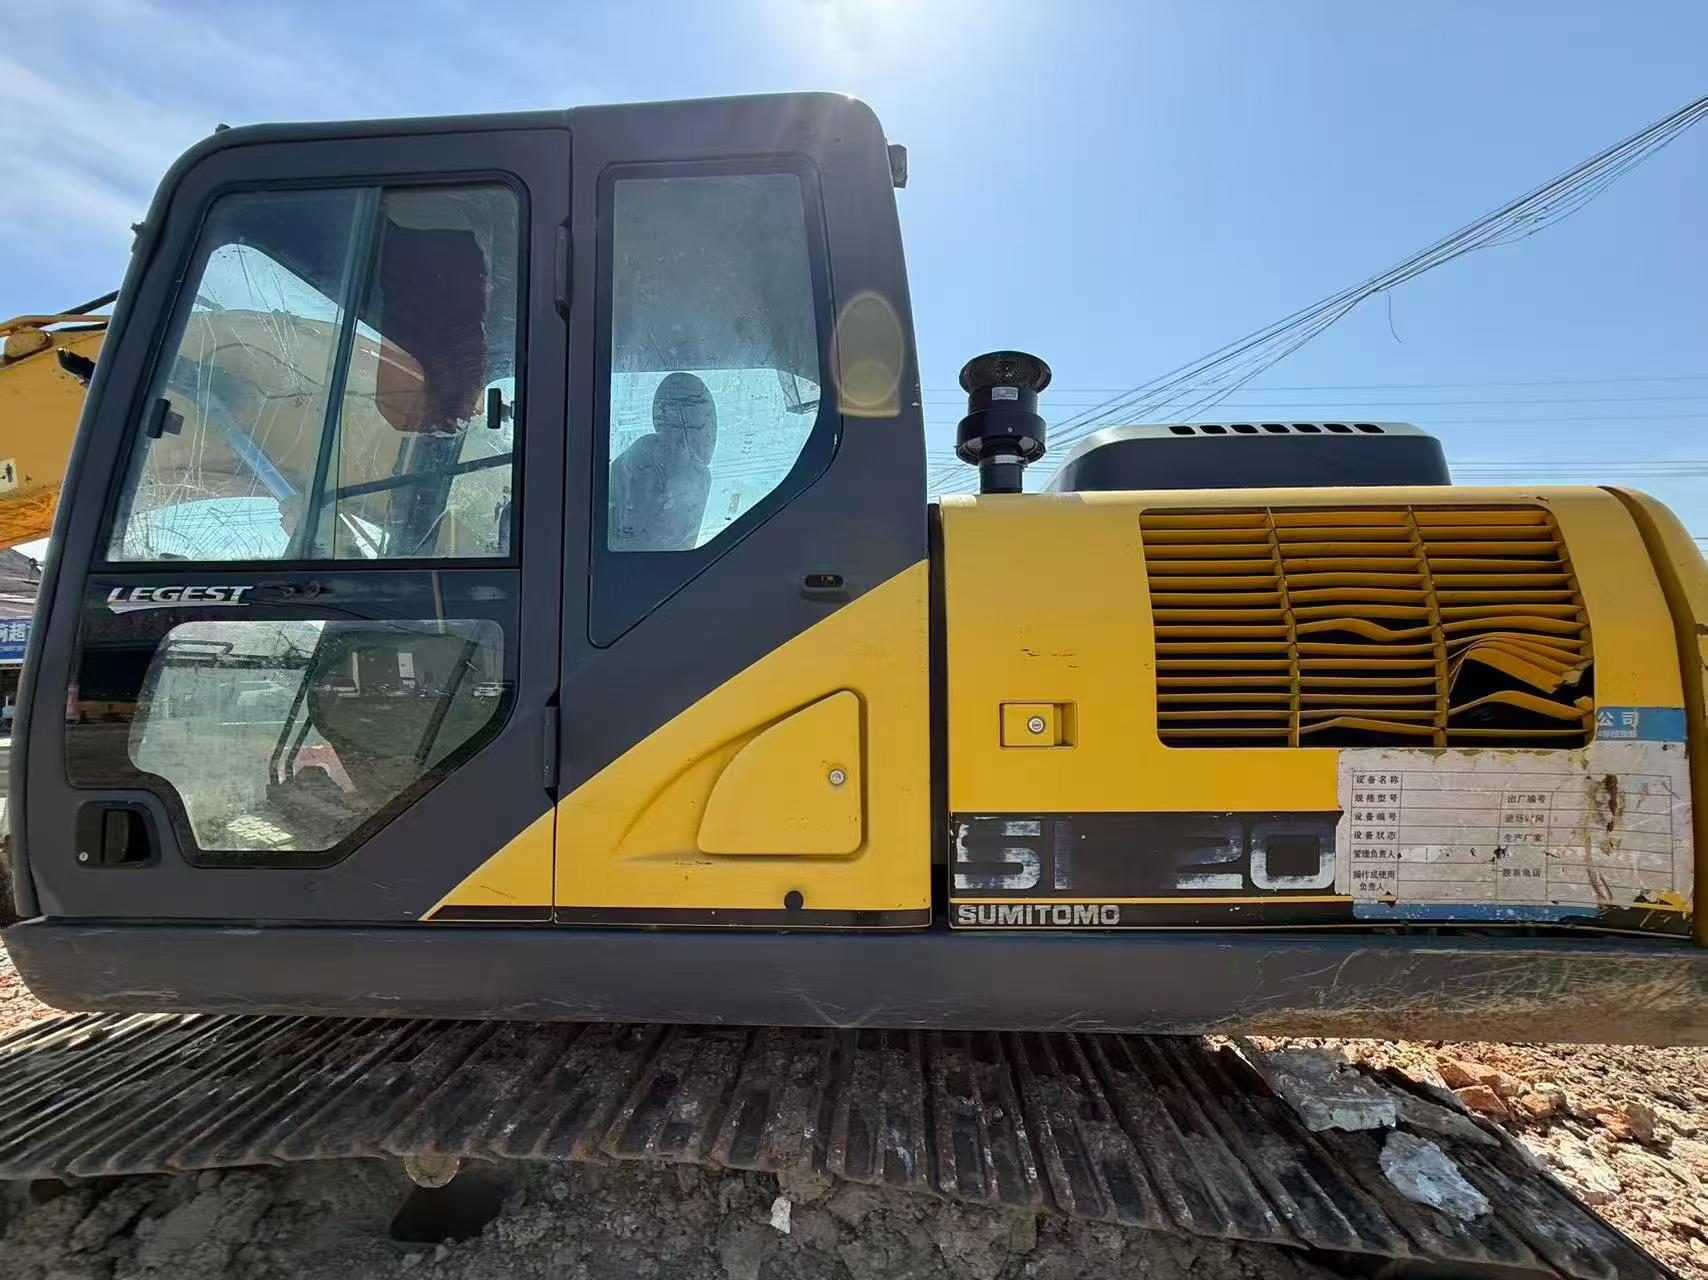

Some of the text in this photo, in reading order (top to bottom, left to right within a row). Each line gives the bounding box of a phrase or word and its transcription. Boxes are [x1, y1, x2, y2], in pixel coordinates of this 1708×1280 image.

[107, 586, 253, 602] LEGEST
[1597, 711, 1638, 728] 公司
[1355, 775, 1399, 784] 设备名称
[1355, 793, 1398, 803] 规格型号
[1507, 794, 1546, 804] 出厂编号
[1354, 812, 1397, 822] 设备编号
[1353, 831, 1396, 840] 设备状态
[1353, 849, 1396, 859] 管理负责人
[1359, 882, 1385, 892] 负责人
[957, 904, 1121, 926] SUMITOMO
